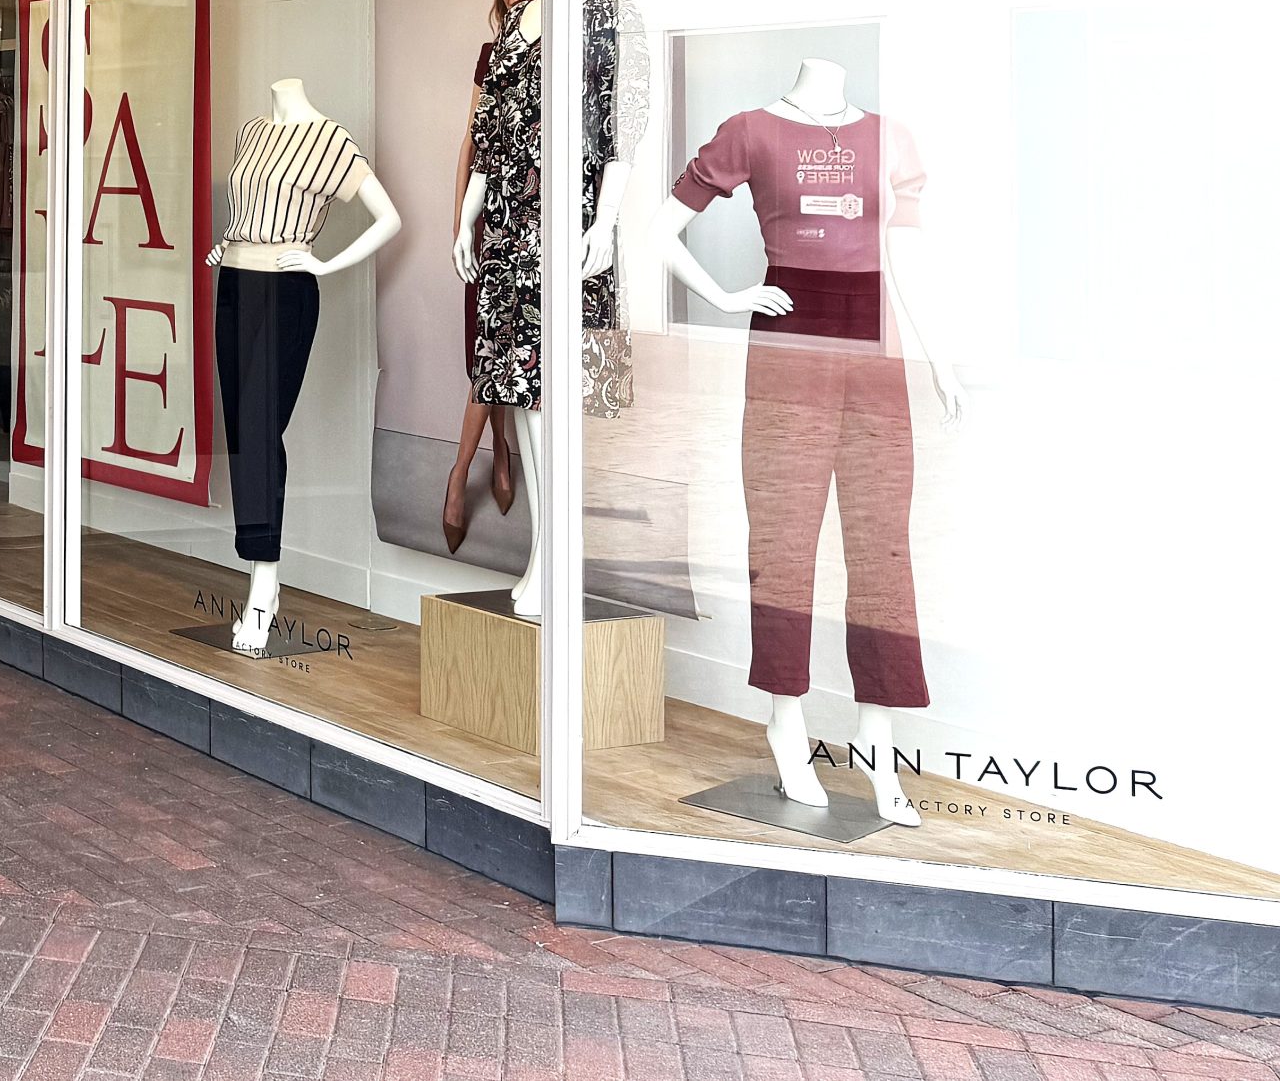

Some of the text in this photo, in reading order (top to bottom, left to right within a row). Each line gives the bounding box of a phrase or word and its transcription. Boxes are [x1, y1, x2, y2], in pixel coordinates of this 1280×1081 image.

[193, 590, 353, 660] ANN TAYLOR
[279, 656, 310, 673] STORE
[807, 739, 1163, 800] ANN TAYLOR
[893, 797, 1071, 826] FACTORY STORE
